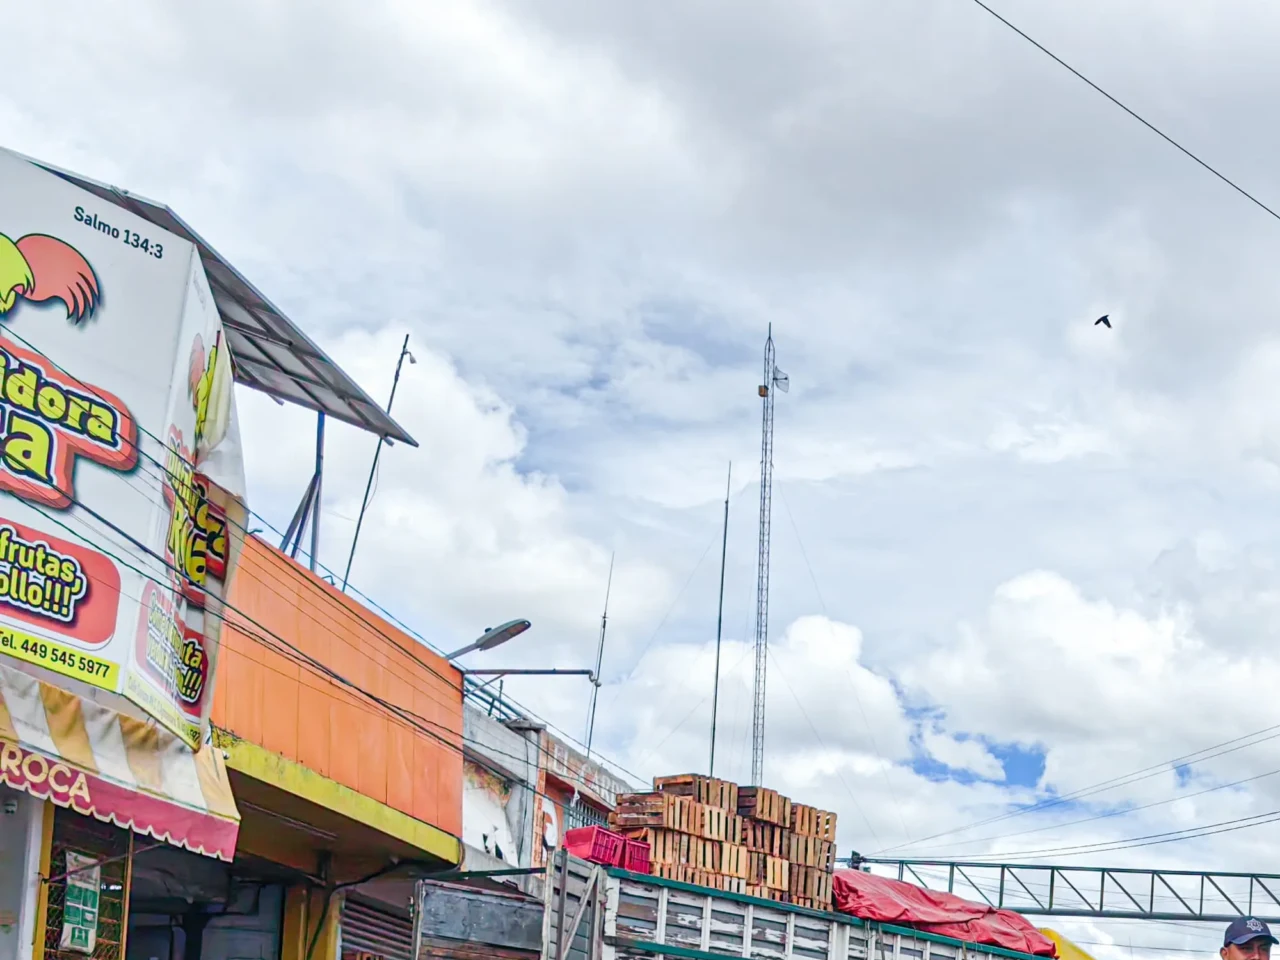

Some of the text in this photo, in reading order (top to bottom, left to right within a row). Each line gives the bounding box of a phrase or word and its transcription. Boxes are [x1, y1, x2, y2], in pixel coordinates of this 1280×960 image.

[73, 206, 164, 259] Salmo 134:3
[21, 639, 47, 659] 449
[51, 648, 75, 668] 545
[79, 657, 110, 678] 5977
[0, 741, 91, 803] ROCA
